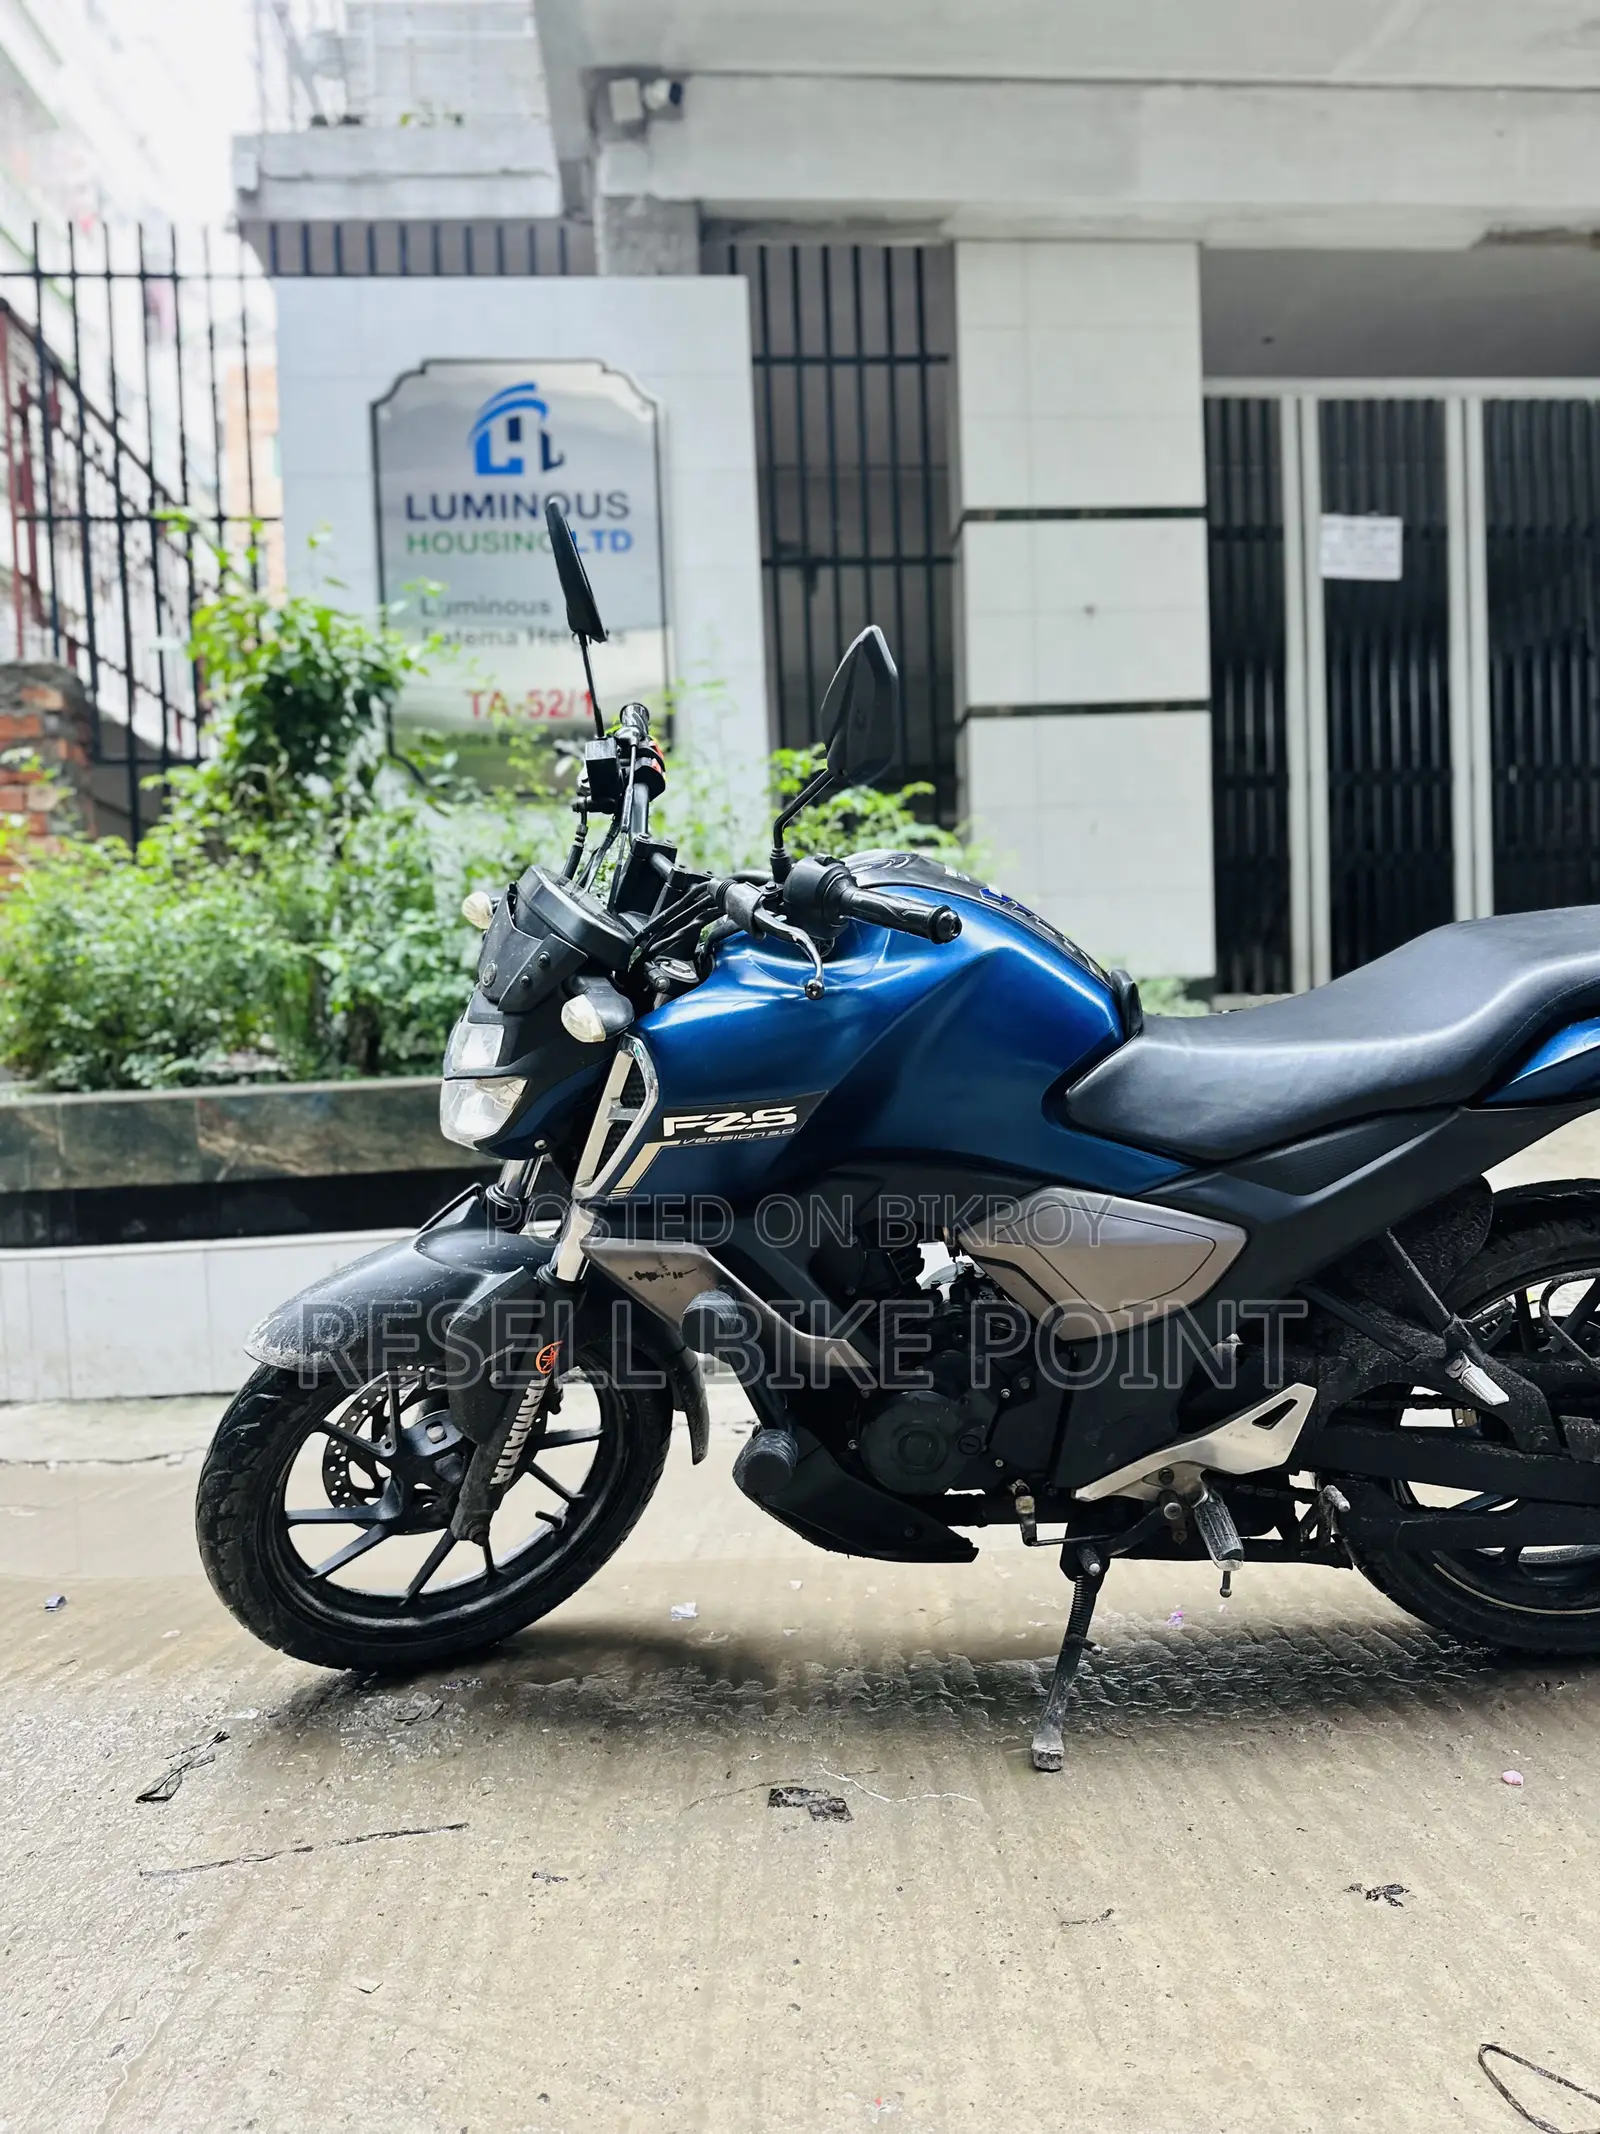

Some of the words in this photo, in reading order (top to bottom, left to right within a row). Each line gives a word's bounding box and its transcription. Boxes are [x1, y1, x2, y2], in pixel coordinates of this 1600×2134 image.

[405, 491, 630, 520] LUMINOUS
[420, 594, 553, 618] Luminous
[682, 1130, 766, 1145] VERSION
